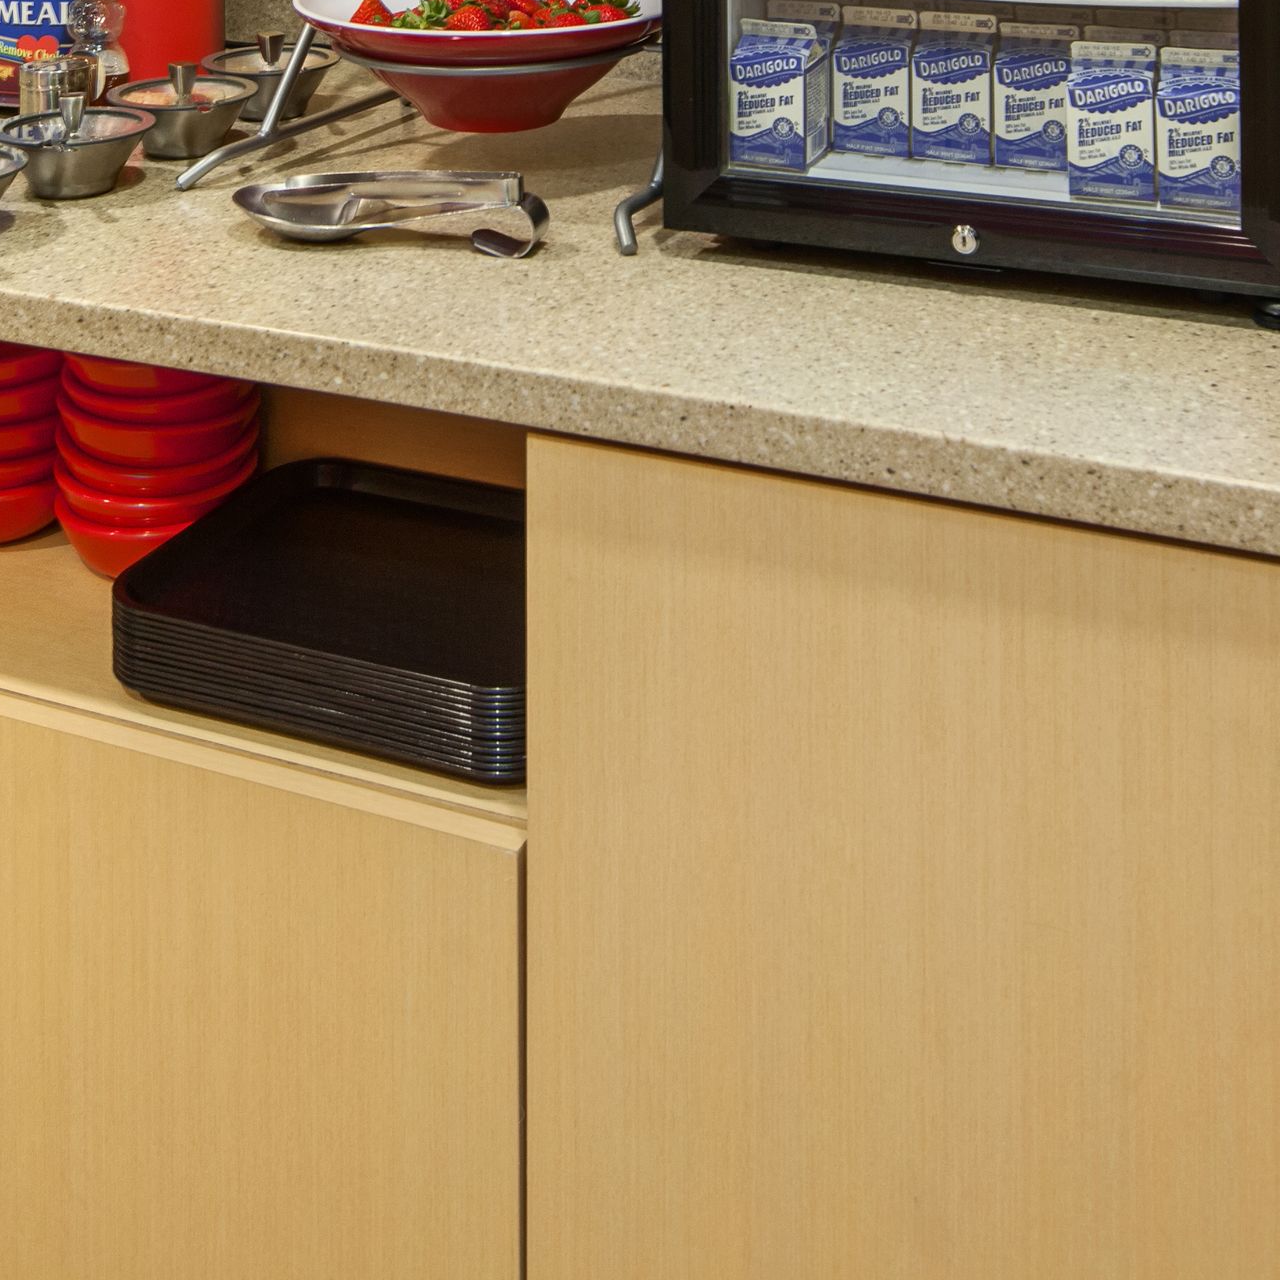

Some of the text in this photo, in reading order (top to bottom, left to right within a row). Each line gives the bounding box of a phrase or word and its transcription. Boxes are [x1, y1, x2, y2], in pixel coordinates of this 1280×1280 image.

[841, 49, 902, 70] DARIGOLD
[920, 54, 983, 76] DARIGOLD
[736, 58, 797, 80] DARIGOLD
[1003, 60, 1067, 83] DARIGOLD
[843, 81, 854, 90] 2%
[843, 86, 899, 100] REDUCED FAT
[922, 87, 934, 96] 2%
[737, 91, 749, 99] 2%
[922, 91, 980, 106] REDUCED FAT
[1005, 94, 1017, 103] 2%
[1074, 81, 1144, 106] DARIGOLD
[737, 95, 794, 110] REDUCED FAT
[1005, 98, 1064, 114] REDUCED FAT
[1164, 91, 1237, 116] DARIGOLD
[1078, 118, 1091, 127] 2%
[1078, 120, 1142, 138] REDUCED FAT
[1168, 128, 1181, 138] 2%
[1168, 131, 1234, 149] REDUCED FAT
